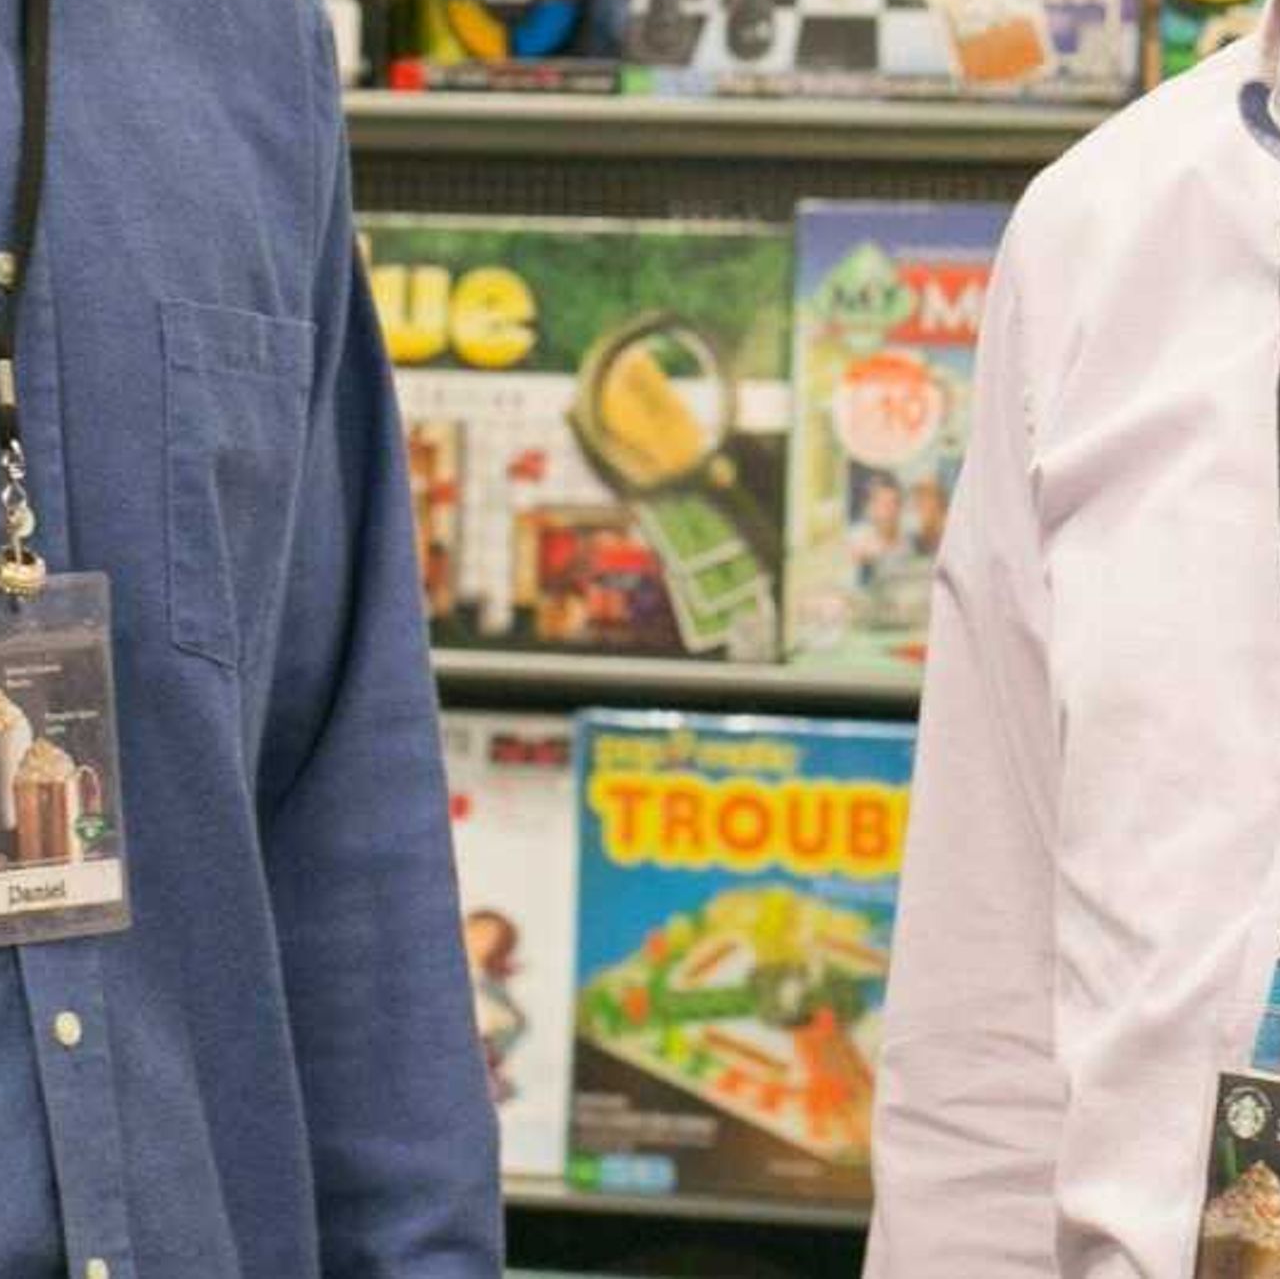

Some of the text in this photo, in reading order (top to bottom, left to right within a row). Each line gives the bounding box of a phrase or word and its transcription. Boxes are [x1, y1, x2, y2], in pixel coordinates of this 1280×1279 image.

[368, 261, 538, 369] ue
[918, 281, 986, 338] M
[603, 781, 894, 864] TROUB
[8, 878, 66, 906] Daniel
